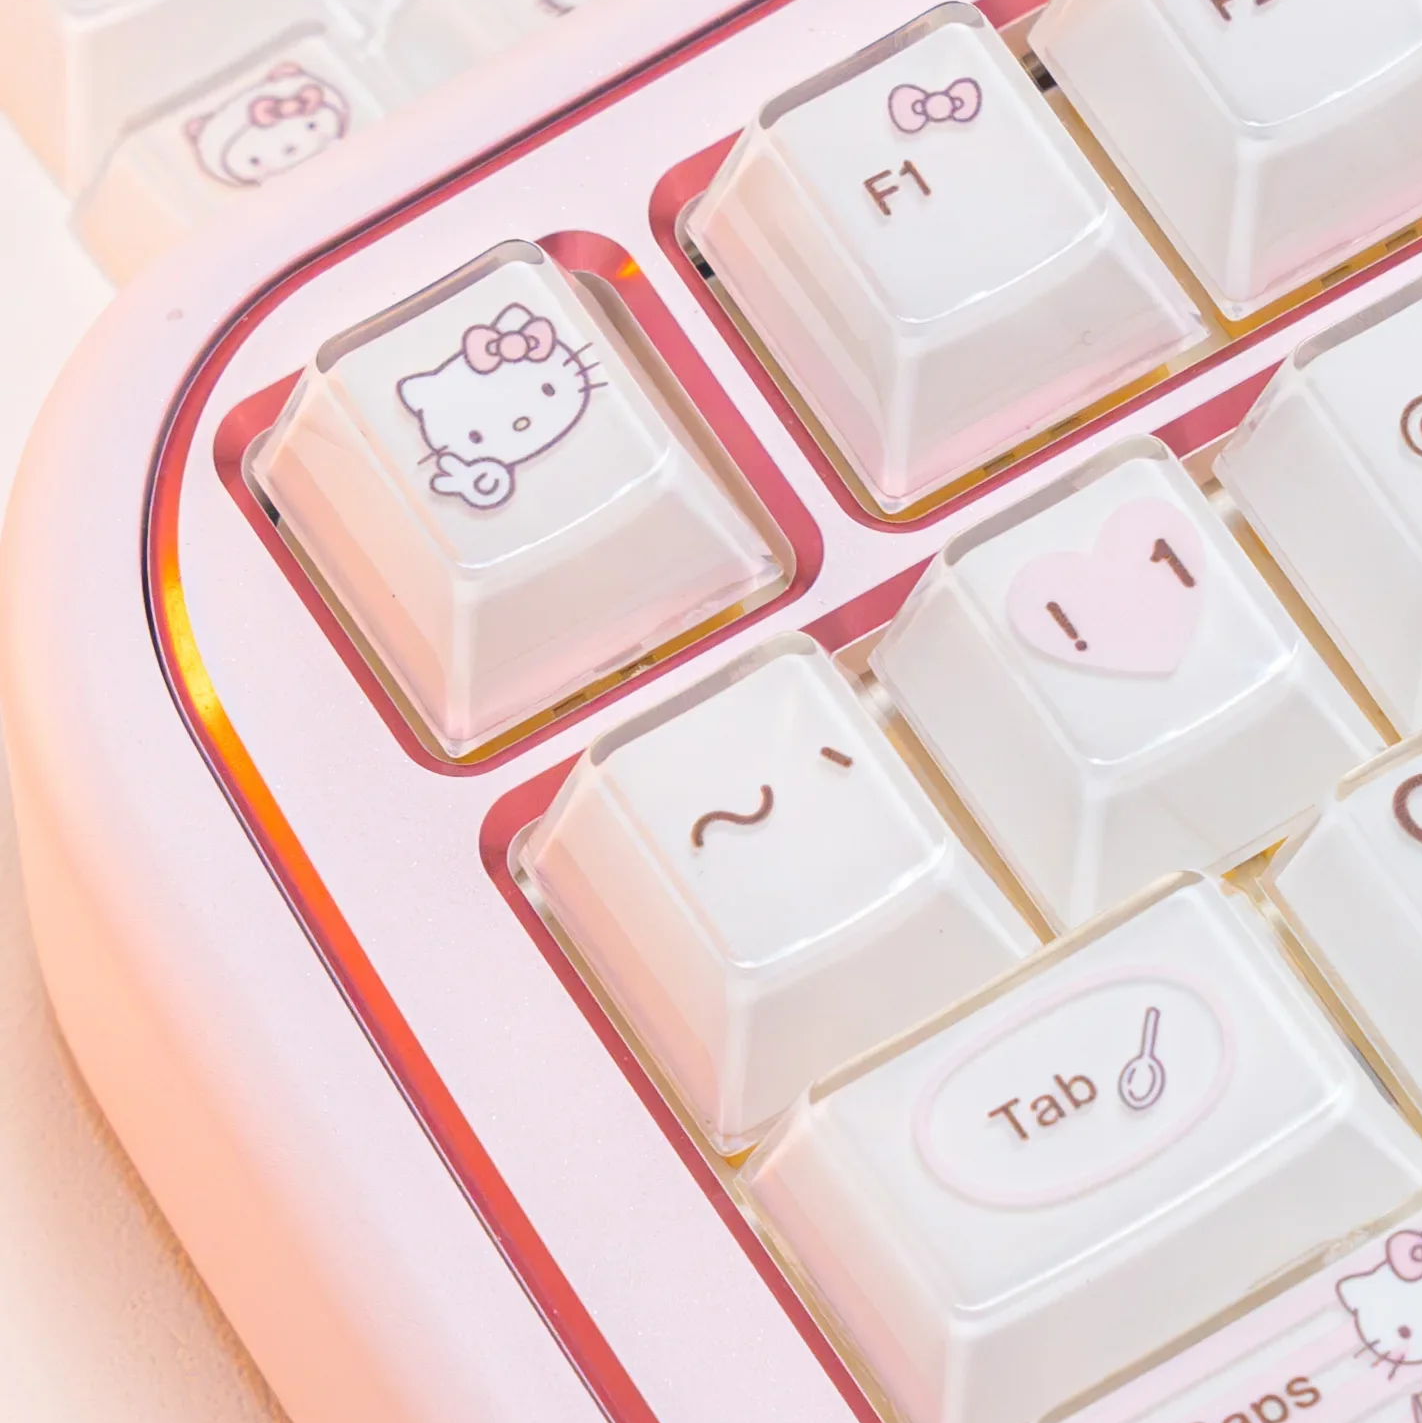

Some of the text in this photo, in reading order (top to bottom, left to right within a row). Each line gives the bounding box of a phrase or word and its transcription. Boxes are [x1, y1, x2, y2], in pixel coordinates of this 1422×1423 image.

[862, 159, 933, 217] F1
[1045, 537, 1197, 653] ! 1
[987, 1073, 1098, 1141] Tab
